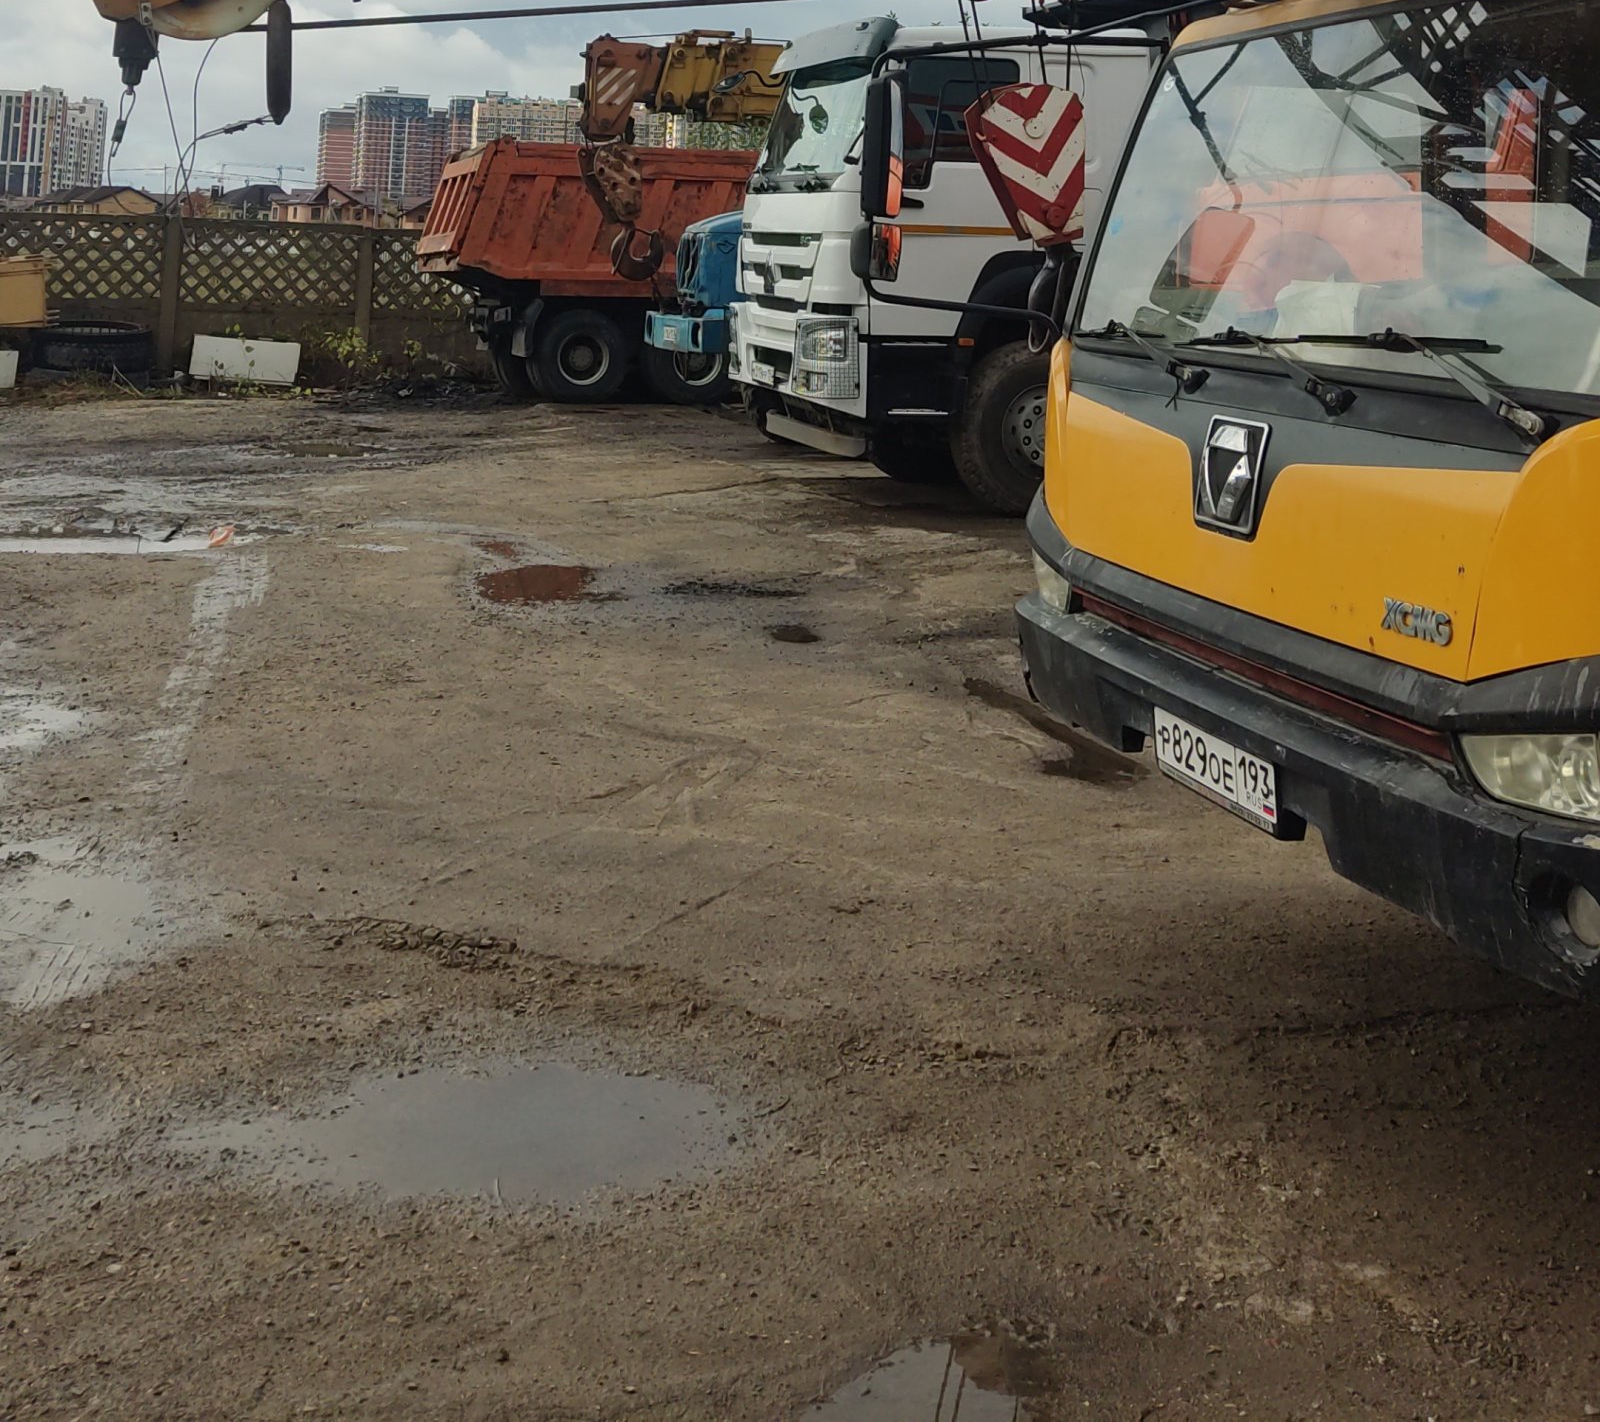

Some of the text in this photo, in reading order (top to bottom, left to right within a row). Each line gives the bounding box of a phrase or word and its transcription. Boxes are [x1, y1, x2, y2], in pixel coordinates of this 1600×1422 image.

[1382, 596, 1453, 647] XCMG
[1161, 723, 1271, 799] Р829ОЕ 193
[1246, 791, 1262, 810] RUS
